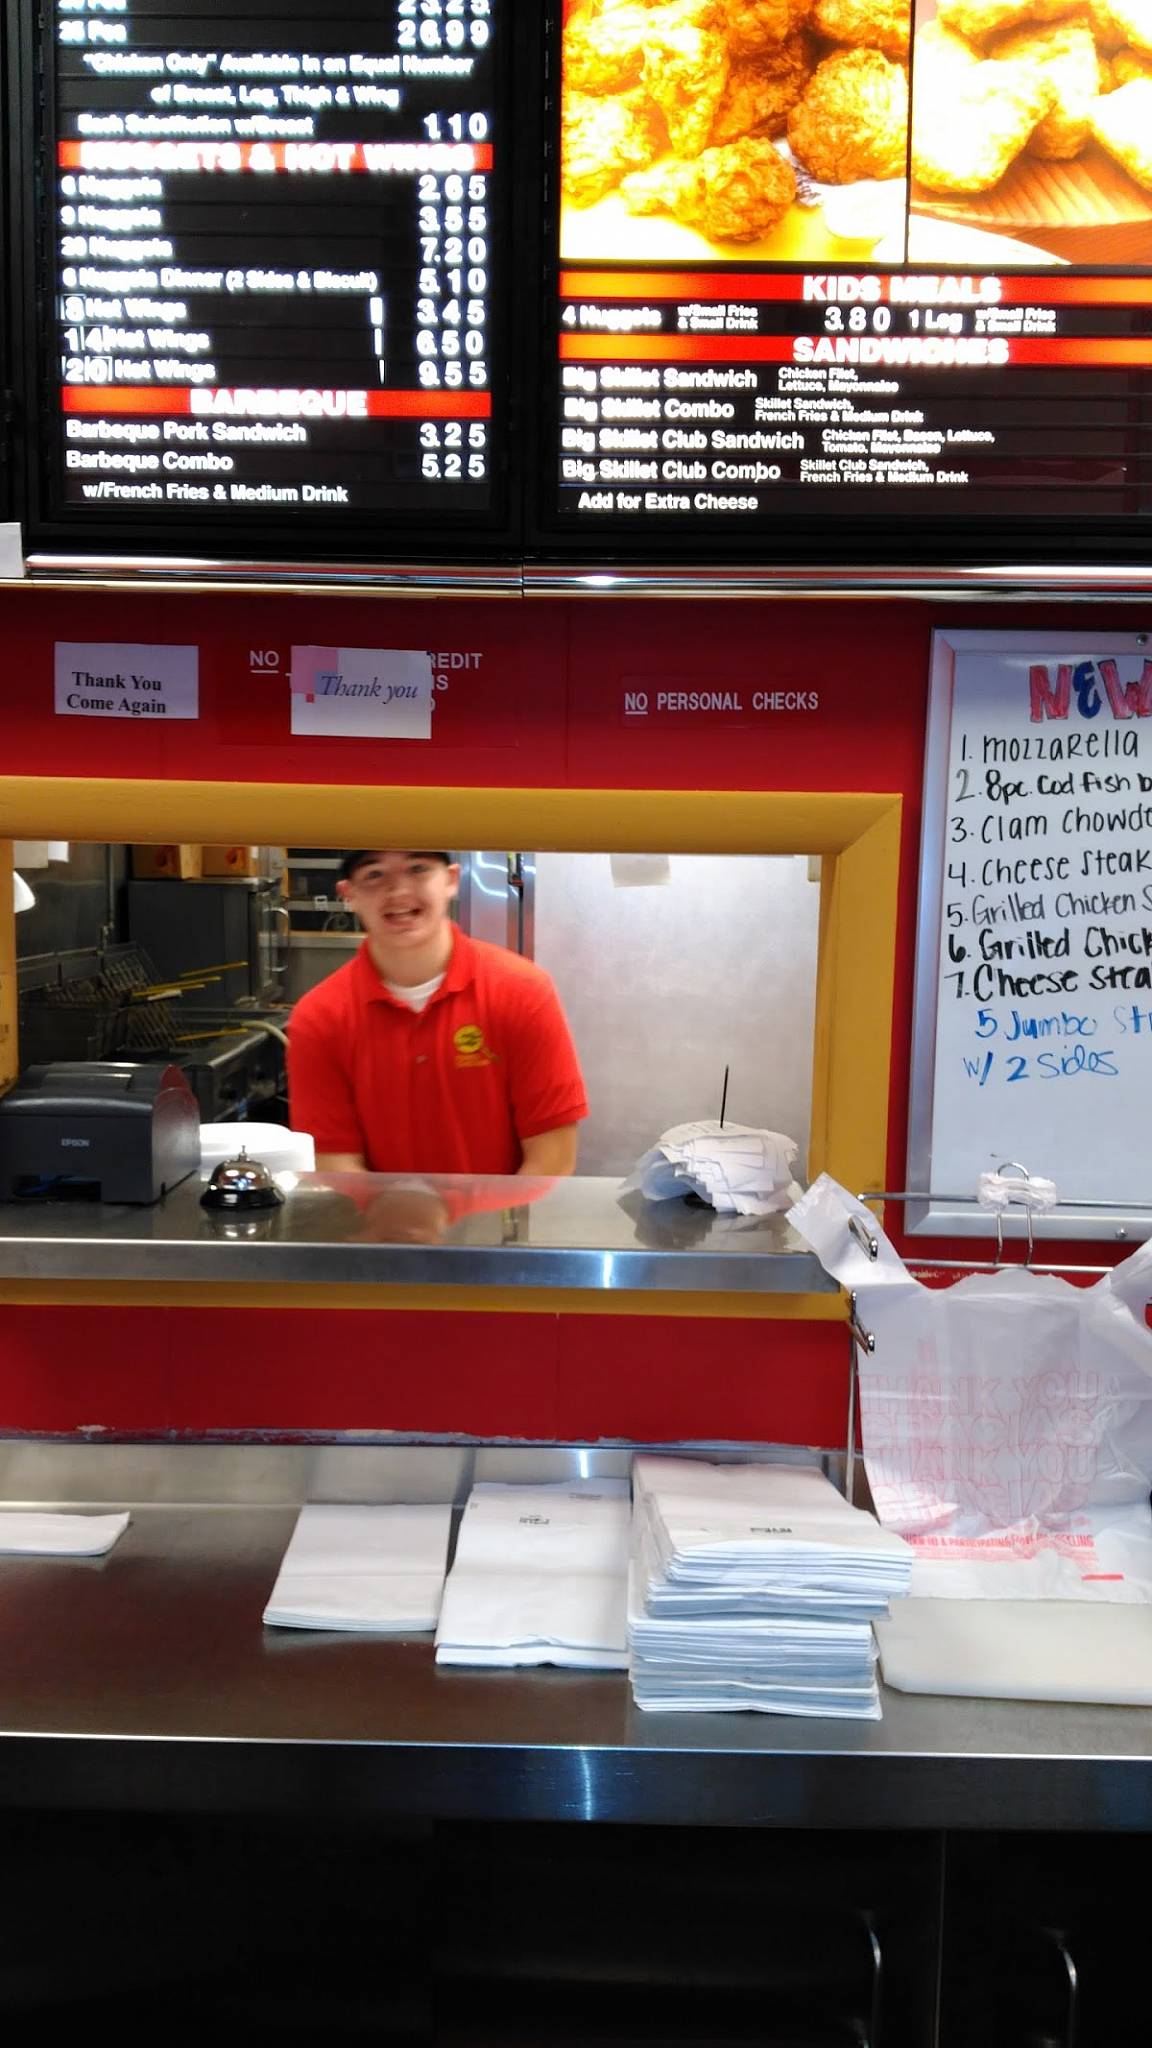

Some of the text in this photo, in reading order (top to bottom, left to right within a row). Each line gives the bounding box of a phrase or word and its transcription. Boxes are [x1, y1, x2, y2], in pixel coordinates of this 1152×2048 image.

[249, 142, 275, 170] &
[285, 143, 355, 171] HOT
[161, 268, 223, 287] Dinner
[296, 271, 311, 289] &
[803, 276, 1002, 303] KIDS MEALS
[85, 298, 186, 322] Hot Wings
[562, 305, 662, 330] 4 Nuggets
[728, 305, 758, 317] Fries
[909, 309, 963, 333] 1 Leg
[1025, 308, 1056, 320] Fries
[726, 318, 758, 329] Drink
[1023, 321, 1056, 332] Drink
[107, 328, 210, 352] Hot Wings
[793, 337, 1009, 364] SANDWICHES
[114, 360, 216, 383] Hot Wings
[563, 367, 757, 391] Big Skillet Sandwich
[779, 368, 827, 380] Chicken
[828, 381, 899, 393] Mayonnaise
[190, 389, 367, 416] BARBEQUE
[564, 398, 735, 422] Big Skillet Combo
[754, 398, 854, 411] Skillet Sandwich,
[755, 410, 924, 423] French Fries & Medium Drink
[66, 420, 306, 442] Barbeque Pork Sandwich
[562, 428, 804, 452] Big Skillet Club Sandwich
[822, 429, 870, 441] Chicken
[871, 442, 941, 454] Mayonnaise
[66, 450, 233, 472] Barbeque Combo
[562, 460, 781, 481] Big Skillet Club Combo
[800, 460, 929, 472] Skillet Club Sandwich,
[800, 471, 969, 483] French Fries & Medium Drink
[83, 482, 348, 501] w/French Fries & Medium Drink
[578, 492, 758, 509] Add for Extra Cheese
[249, 650, 280, 667] NO
[71, 671, 162, 691] Thank You
[320, 675, 381, 697] Thank
[382, 685, 418, 704] you
[66, 693, 166, 716] Come Again
[625, 691, 819, 710] NO PERSONAL CHECKS
[955, 768, 982, 802] 2.
[1037, 772, 1075, 796] Cod
[950, 816, 974, 843] 3.
[981, 814, 1047, 844] Clam
[948, 861, 976, 888] 4.
[982, 857, 1070, 886] Cheese
[947, 902, 969, 928] 5.
[972, 893, 1046, 925] Grilled
[1055, 891, 1136, 920] Chicken
[948, 934, 971, 963] 6.
[979, 928, 1070, 961] Grilled
[944, 971, 970, 998] 7.
[974, 964, 1079, 1001] Cheese
[975, 1008, 1097, 1041] 5 Jumbo
[1006, 1056, 1029, 1082] 2
